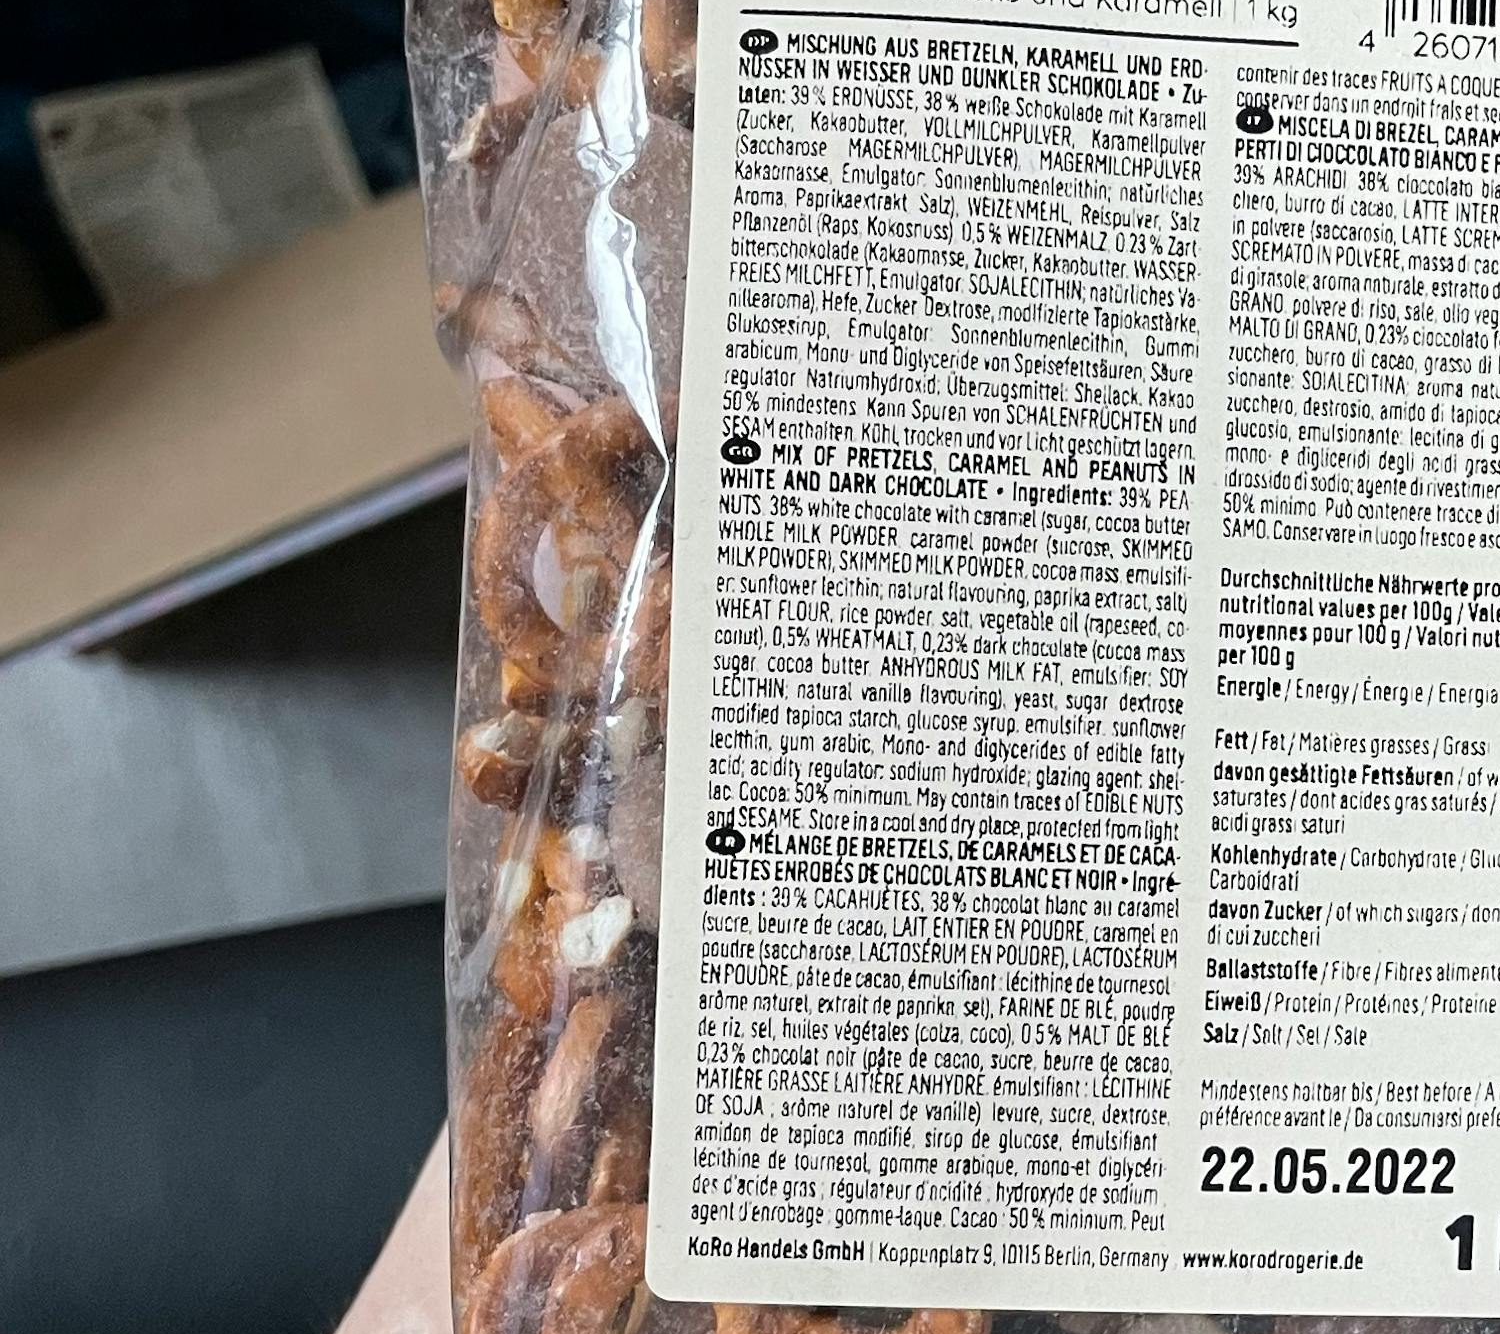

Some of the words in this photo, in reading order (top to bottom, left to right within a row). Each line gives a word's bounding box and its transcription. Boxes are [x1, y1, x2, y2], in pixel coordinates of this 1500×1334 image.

[786, 32, 876, 56] MISCHUNG
[883, 37, 919, 58] AUS
[1026, 46, 1117, 73] KARAMELL
[1126, 54, 1162, 76] UND
[1358, 29, 1375, 53] 4
[812, 58, 829, 80] IN
[836, 59, 911, 87] WEISSER
[918, 64, 953, 86] UND
[961, 67, 1040, 93] DUNKLER
[1047, 72, 1160, 102] SCHOKOLADE
[1181, 82, 1207, 105] Zu-
[1278, 114, 1349, 139] MISCELA
[1234, 137, 1282, 161] PERTI
[1306, 141, 1410, 168] CIOCCOLATO
[1414, 148, 1476, 172] BIANCO
[771, 443, 803, 465] MIX
[813, 444, 835, 466] OF
[948, 451, 1031, 476] CARAMEL
[1041, 455, 1078, 479] AND
[1088, 458, 1168, 483] PEANUTS
[1178, 464, 1195, 485] IN
[720, 467, 775, 490] WHITE
[783, 468, 820, 492] AND
[828, 470, 876, 494] DARK
[884, 474, 988, 499] CHOCOLATE
[1012, 480, 1112, 506] Ingredients:
[1119, 485, 1151, 508] 39%
[1220, 567, 1373, 593] Durchschnittliche
[1378, 573, 1468, 597] Nährwerte
[1472, 581, 1500, 601] pro
[1219, 593, 1313, 616] nutritional
[1318, 597, 1375, 618] values
[1379, 603, 1407, 623] per
[1412, 599, 1452, 625] 100g
[1218, 622, 1307, 643] moyennes
[1312, 625, 1353, 646] pour
[1358, 621, 1386, 644] 100
[1390, 629, 1400, 649] g
[1416, 624, 1467, 647] Valori
[1217, 648, 1246, 667] per
[1251, 644, 1280, 666] 100
[1285, 650, 1294, 670] g
[1295, 677, 1349, 705] Energy
[1362, 679, 1423, 707] Énergie
[1438, 682, 1498, 708] Energia
[1214, 727, 1248, 750] Fett
[1261, 729, 1285, 751] Fat
[1299, 731, 1366, 753] Matières
[1370, 738, 1429, 758] grasses
[1213, 760, 1264, 782] davon
[1361, 763, 1453, 786] Fettsäuren
[748, 832, 832, 856] MÉLANGE
[835, 835, 858, 860] DE
[957, 839, 979, 860] DE
[982, 840, 1076, 863] CARAMELS
[1079, 843, 1100, 864] ET
[1104, 843, 1126, 865] DE
[774, 859, 854, 883] ENROBÉS
[857, 861, 879, 884] DE
[883, 862, 986, 888] CHOCOLATS
[990, 866, 1048, 889] BLANC
[1051, 867, 1070, 889] ET
[1075, 868, 1117, 890] NOIR
[1208, 898, 1259, 920] davon
[1263, 899, 1323, 921] Zucker
[1355, 902, 1402, 922] which
[1406, 906, 1458, 927] sugars
[1205, 957, 1317, 981] Ballaststoffe
[1331, 960, 1370, 981] Fibre
[1384, 961, 1432, 982] Fibres
[1204, 989, 1261, 1011] Eiweiß
[1274, 991, 1330, 1013] Protein
[1431, 992, 1496, 1013] Proteine
[1201, 1145, 1455, 1195] 22.05.2022
[688, 1235, 732, 1257] KoRo
[736, 1236, 808, 1259] Handels
[812, 1238, 864, 1261] GmbH
[1002, 1242, 1040, 1264] 10115
[1044, 1243, 1094, 1268] Berlin,
[1099, 1245, 1169, 1272] Germany
[1444, 1214, 1474, 1270] 1
[1182, 1248, 1363, 1274] www.korodrogerie.de
